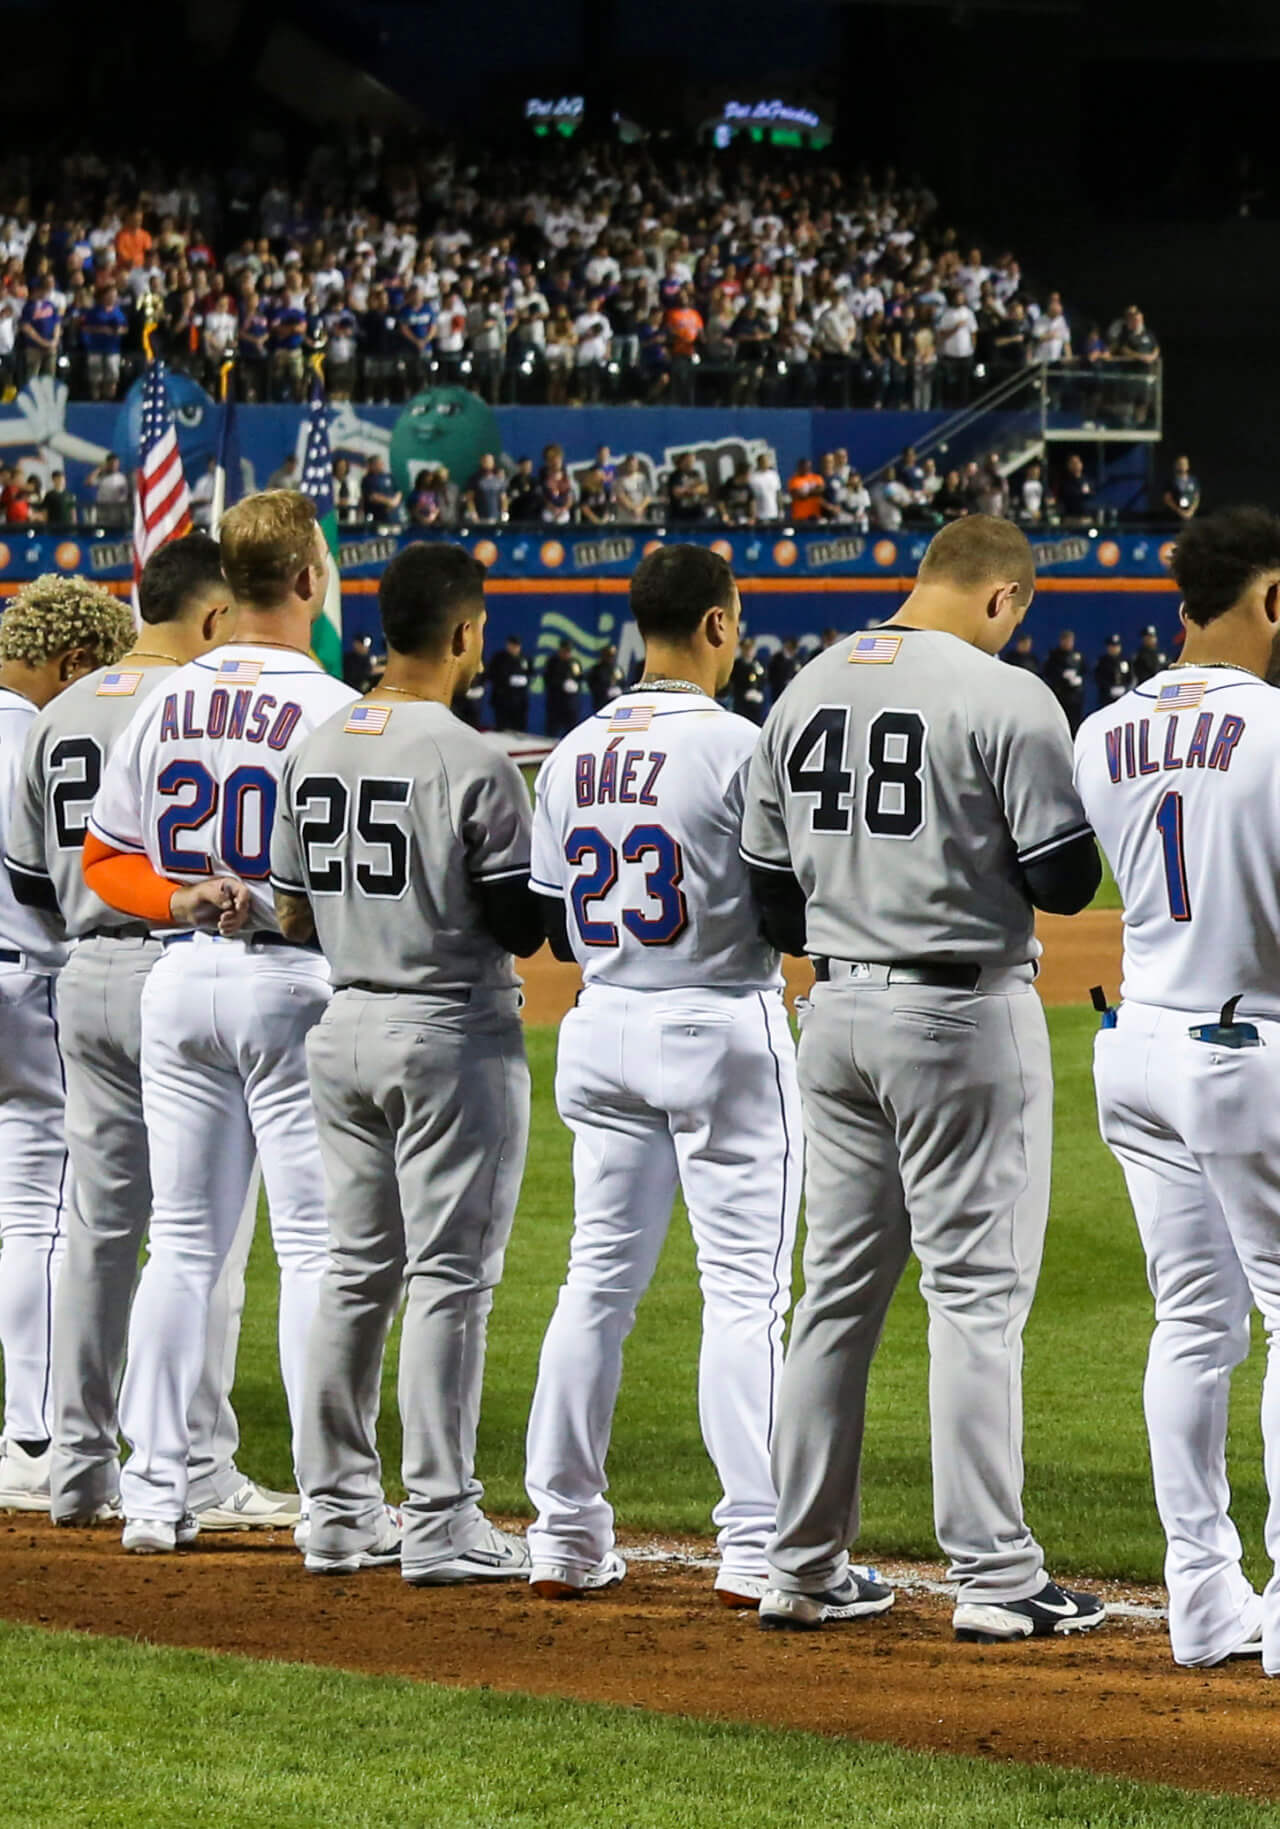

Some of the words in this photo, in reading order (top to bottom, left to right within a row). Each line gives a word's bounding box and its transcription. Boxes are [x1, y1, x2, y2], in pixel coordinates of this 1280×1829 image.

[160, 689, 302, 750] ALONSO
[575, 736, 667, 808] BÁEZ
[784, 704, 929, 841] 48
[1105, 712, 1246, 784] VILLAR
[158, 759, 278, 879] 20
[295, 773, 414, 900] 25
[1156, 791, 1192, 922] 1
[564, 824, 689, 947] 23
